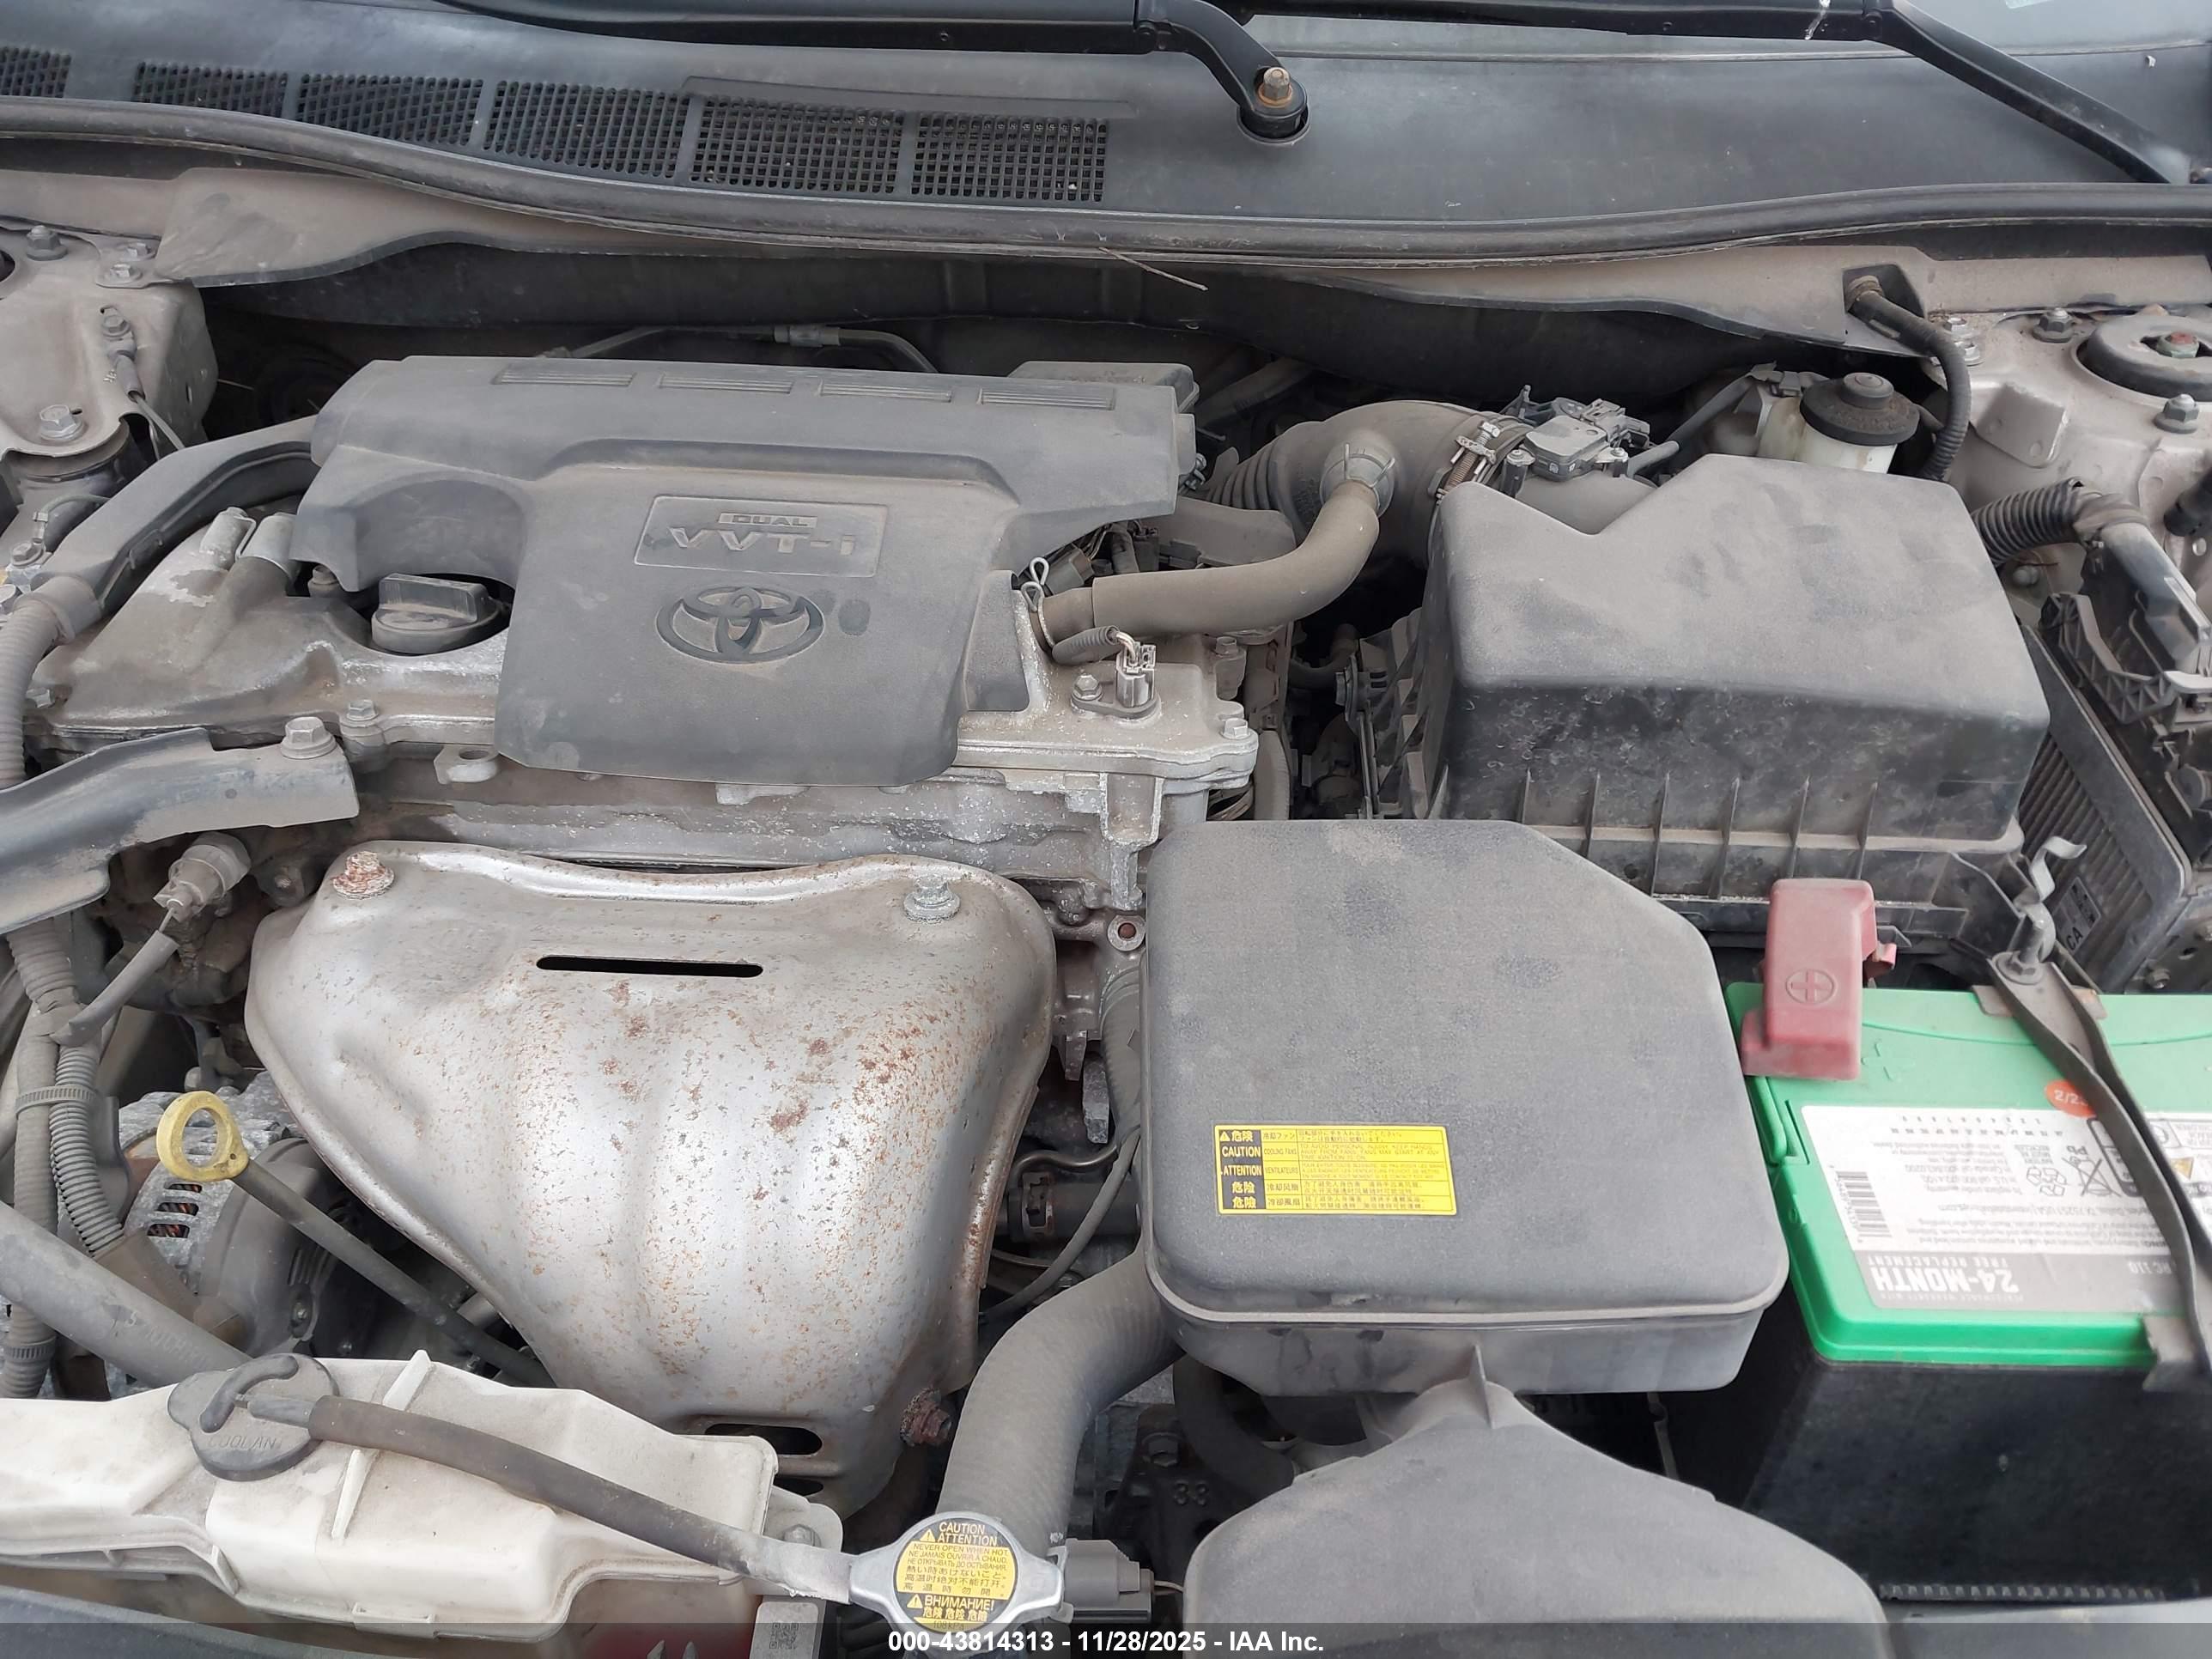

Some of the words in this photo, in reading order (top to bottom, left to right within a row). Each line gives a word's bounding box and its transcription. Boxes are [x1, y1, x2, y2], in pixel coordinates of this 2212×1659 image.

[732, 515, 808, 526] DUAL
[669, 526, 855, 555] VVT-i
[1231, 1130, 1253, 1142] 危険
[1221, 1146, 1261, 1158] CAUTION
[1223, 1164, 1262, 1176] ATTENTION
[1867, 1255, 1968, 1268] REPLACEMENT
[1972, 1256, 2009, 1268] FREE
[1873, 1267, 2020, 1292] 24-MONTH
[939, 1522, 985, 1534] CAUTION
[938, 1534, 998, 1546] ATTENTION
[914, 1543, 940, 1552] NEVER
[966, 1546, 990, 1554] WHEN
[924, 1595, 995, 1610] ВНИМАНИЕ!
